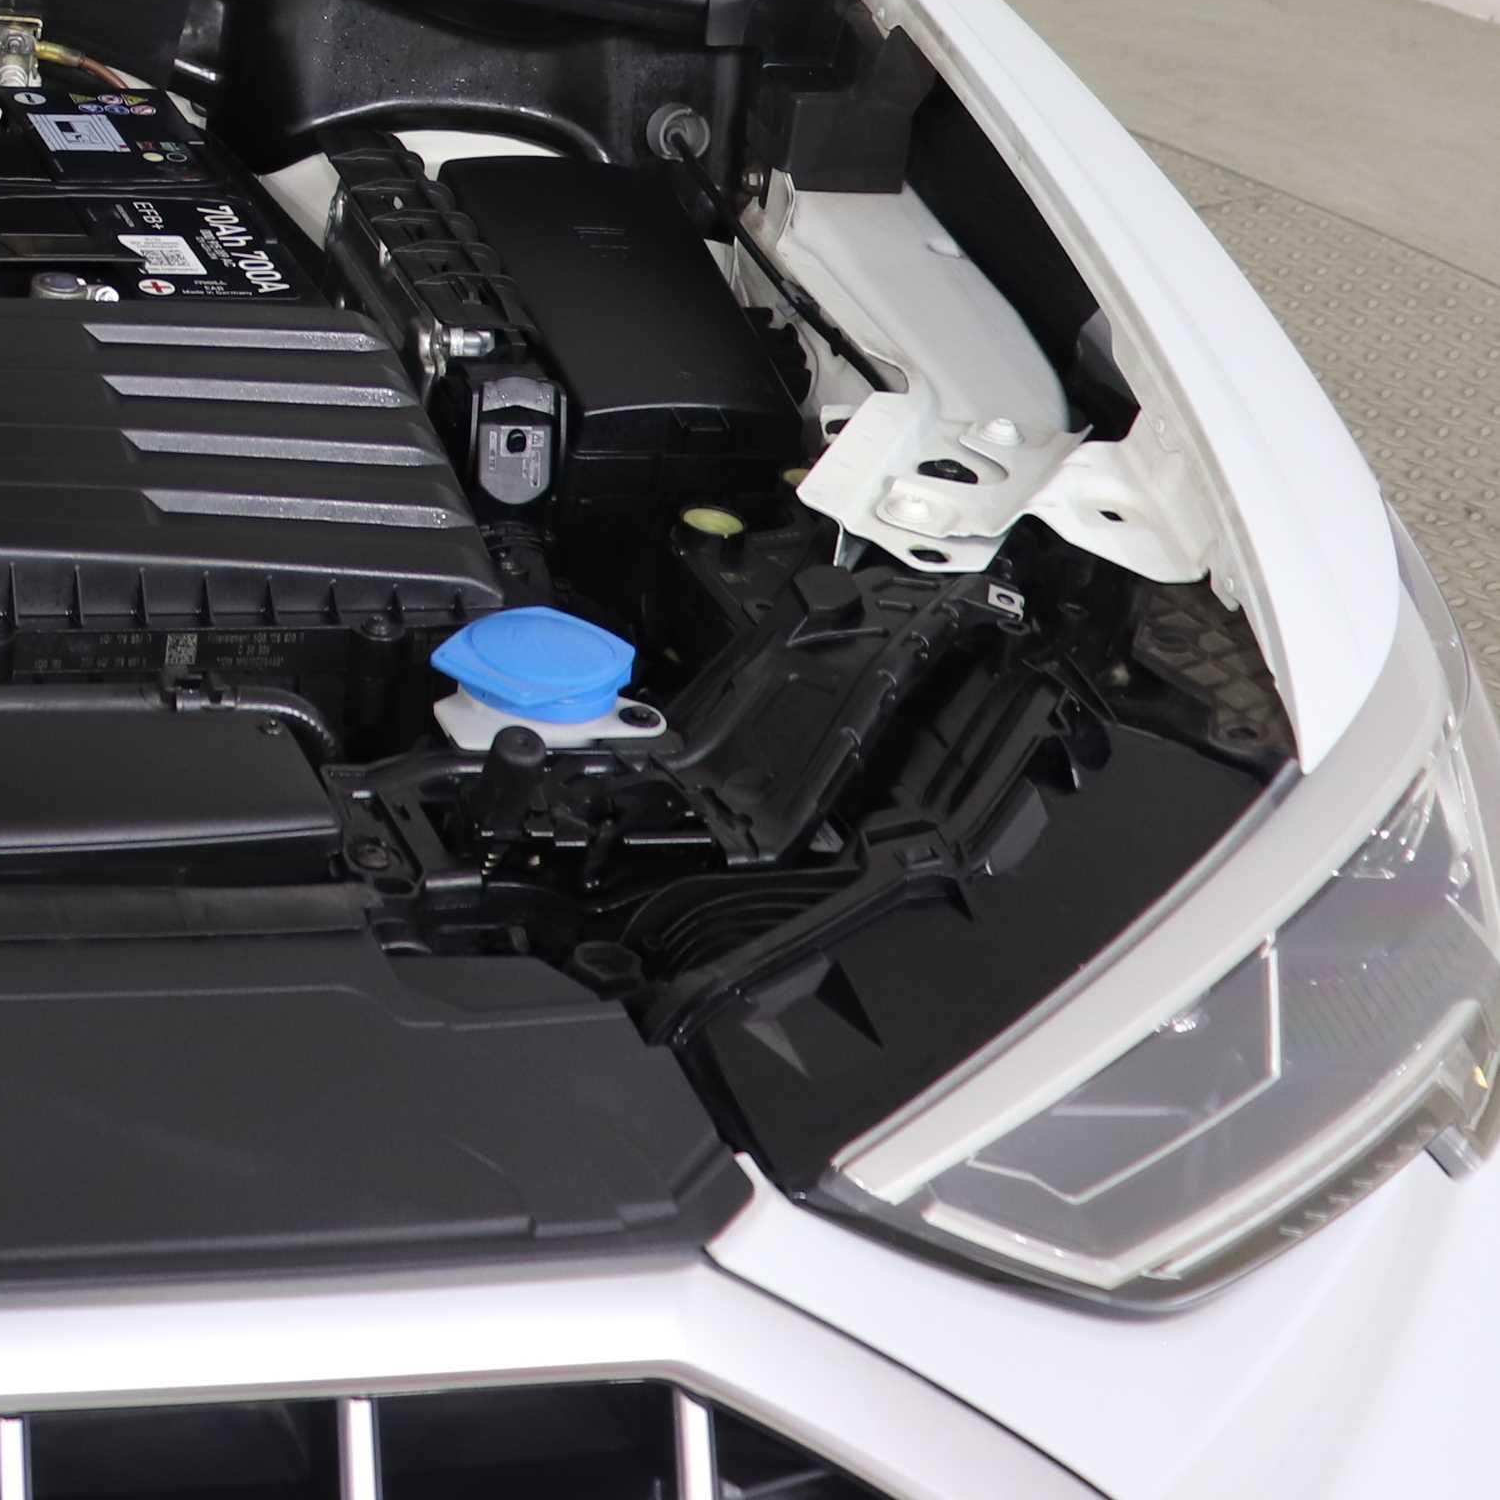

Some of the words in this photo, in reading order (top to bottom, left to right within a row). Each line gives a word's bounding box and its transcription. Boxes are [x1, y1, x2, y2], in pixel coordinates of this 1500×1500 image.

[133, 201, 164, 230] EFB+
[196, 204, 253, 247] 70Ah
[230, 250, 290, 293] 700A
